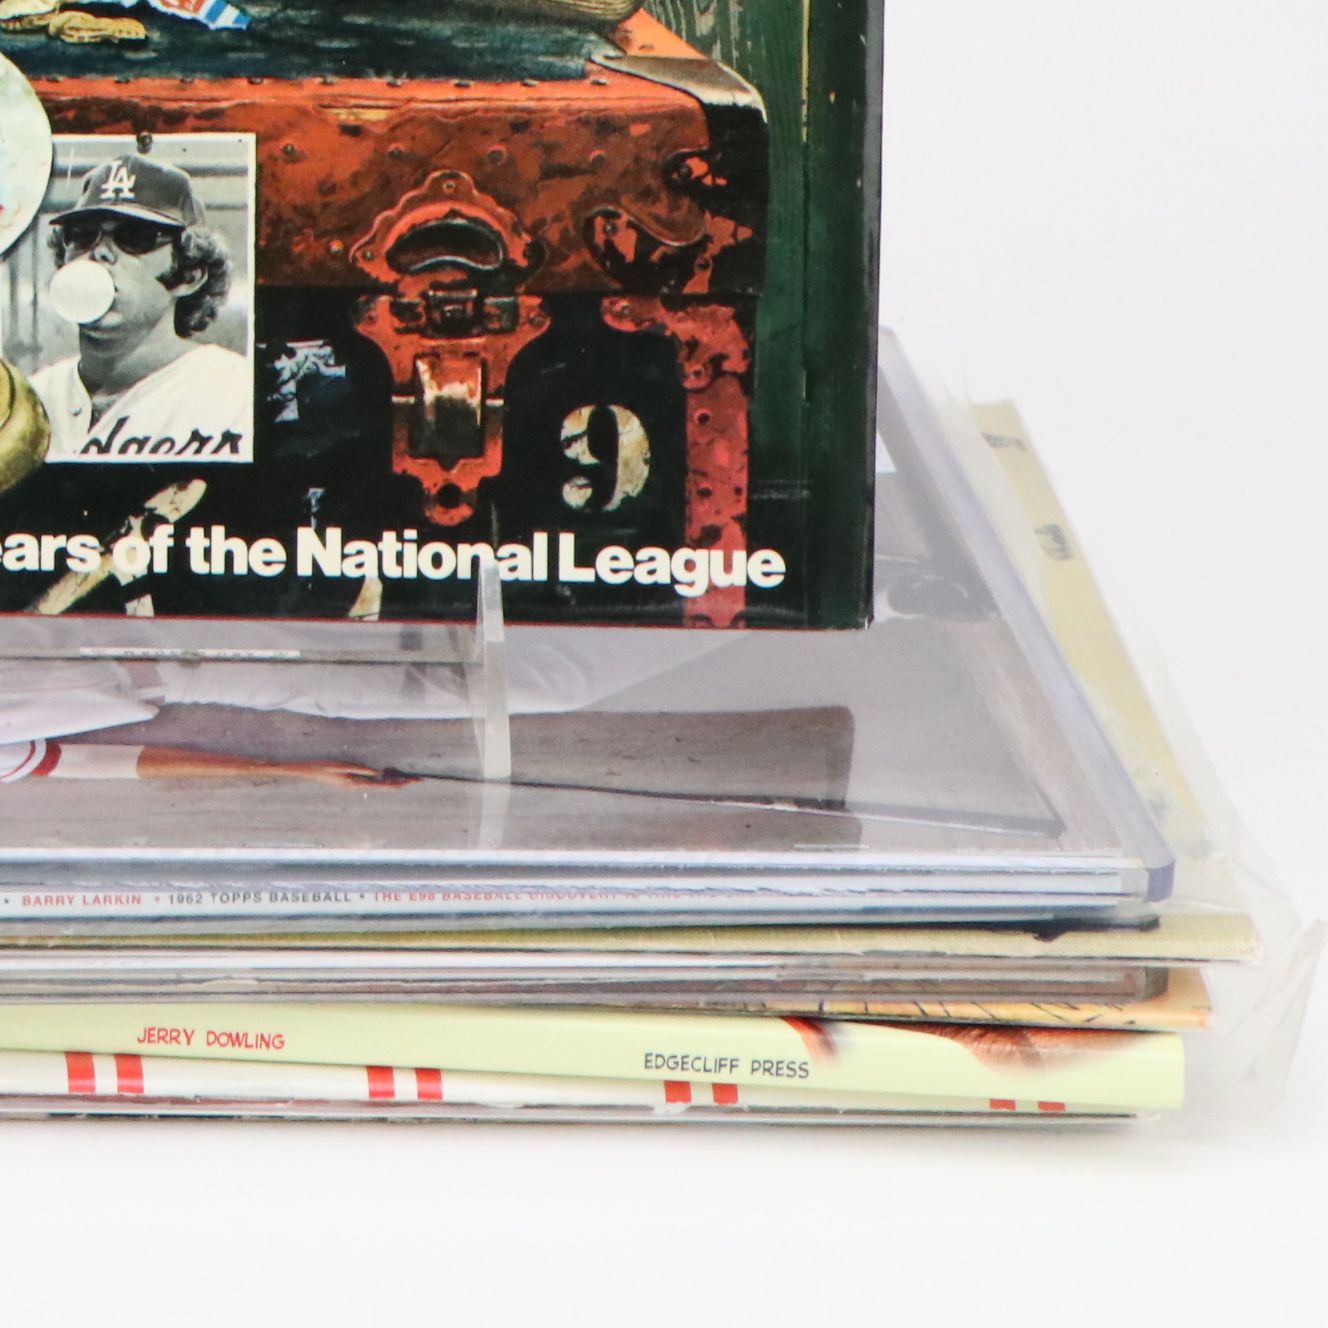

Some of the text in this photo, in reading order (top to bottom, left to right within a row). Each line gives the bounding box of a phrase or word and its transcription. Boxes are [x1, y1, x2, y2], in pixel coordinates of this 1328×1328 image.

[111, 523, 179, 576] of
[186, 525, 287, 576] the
[297, 529, 548, 586] National
[557, 533, 787, 597] League
[22, 894, 76, 907] BARRY
[82, 894, 142, 906] LARKIN
[168, 893, 203, 905] 1962
[210, 892, 263, 905] TOPPS
[269, 891, 351, 903] BASEBALL
[373, 891, 402, 902] THE
[137, 1027, 196, 1046] JERRY
[206, 1030, 286, 1050] DOWLING
[644, 1052, 740, 1074] EDGECLIFF
[751, 1061, 810, 1079] PRESS
